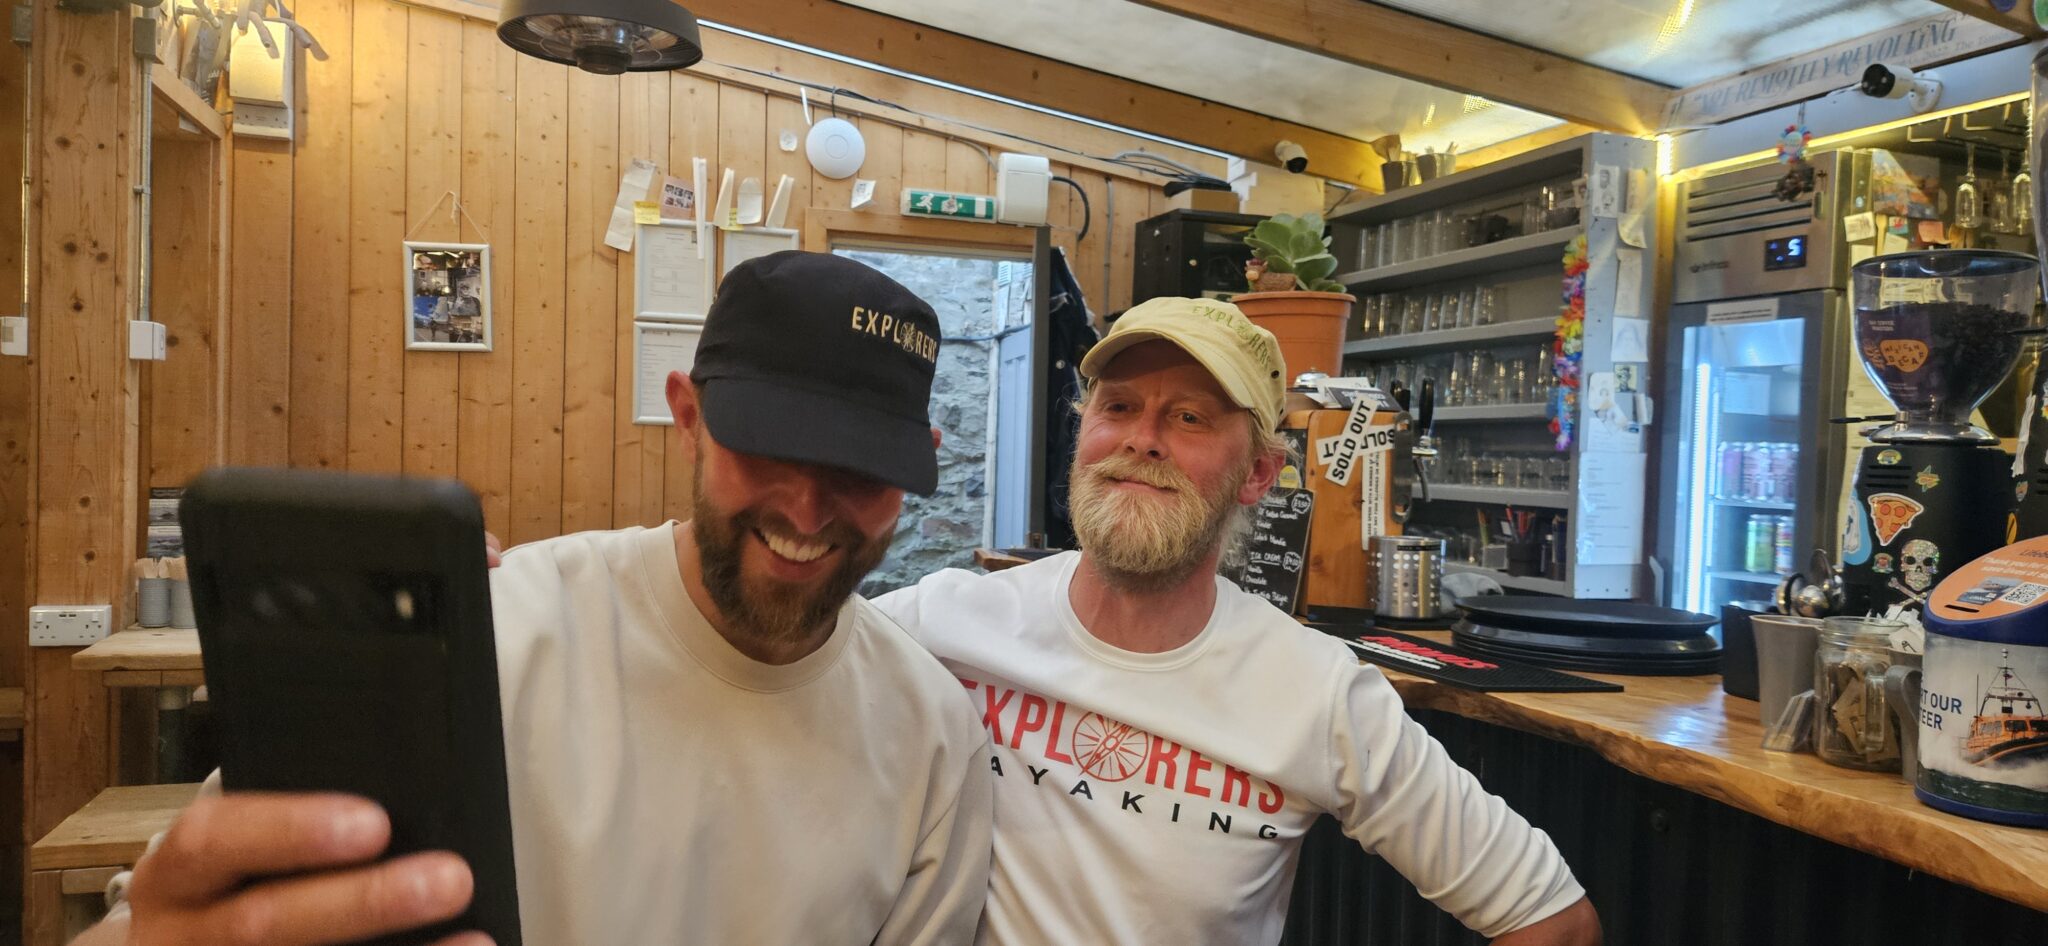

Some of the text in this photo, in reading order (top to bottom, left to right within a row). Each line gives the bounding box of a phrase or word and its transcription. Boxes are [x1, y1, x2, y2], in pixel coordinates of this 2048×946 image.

[1735, 56, 1832, 104] REMOTELY
[1836, 20, 1957, 77] REVOLTING
[1332, 438, 1357, 481] SOLD
[1350, 400, 1371, 435] OUT
[1920, 707, 1942, 731] EER
[1931, 693, 1962, 715] OUR
[957, 678, 1286, 815] XPLORERS
[991, 755, 1278, 840] AYAKING
